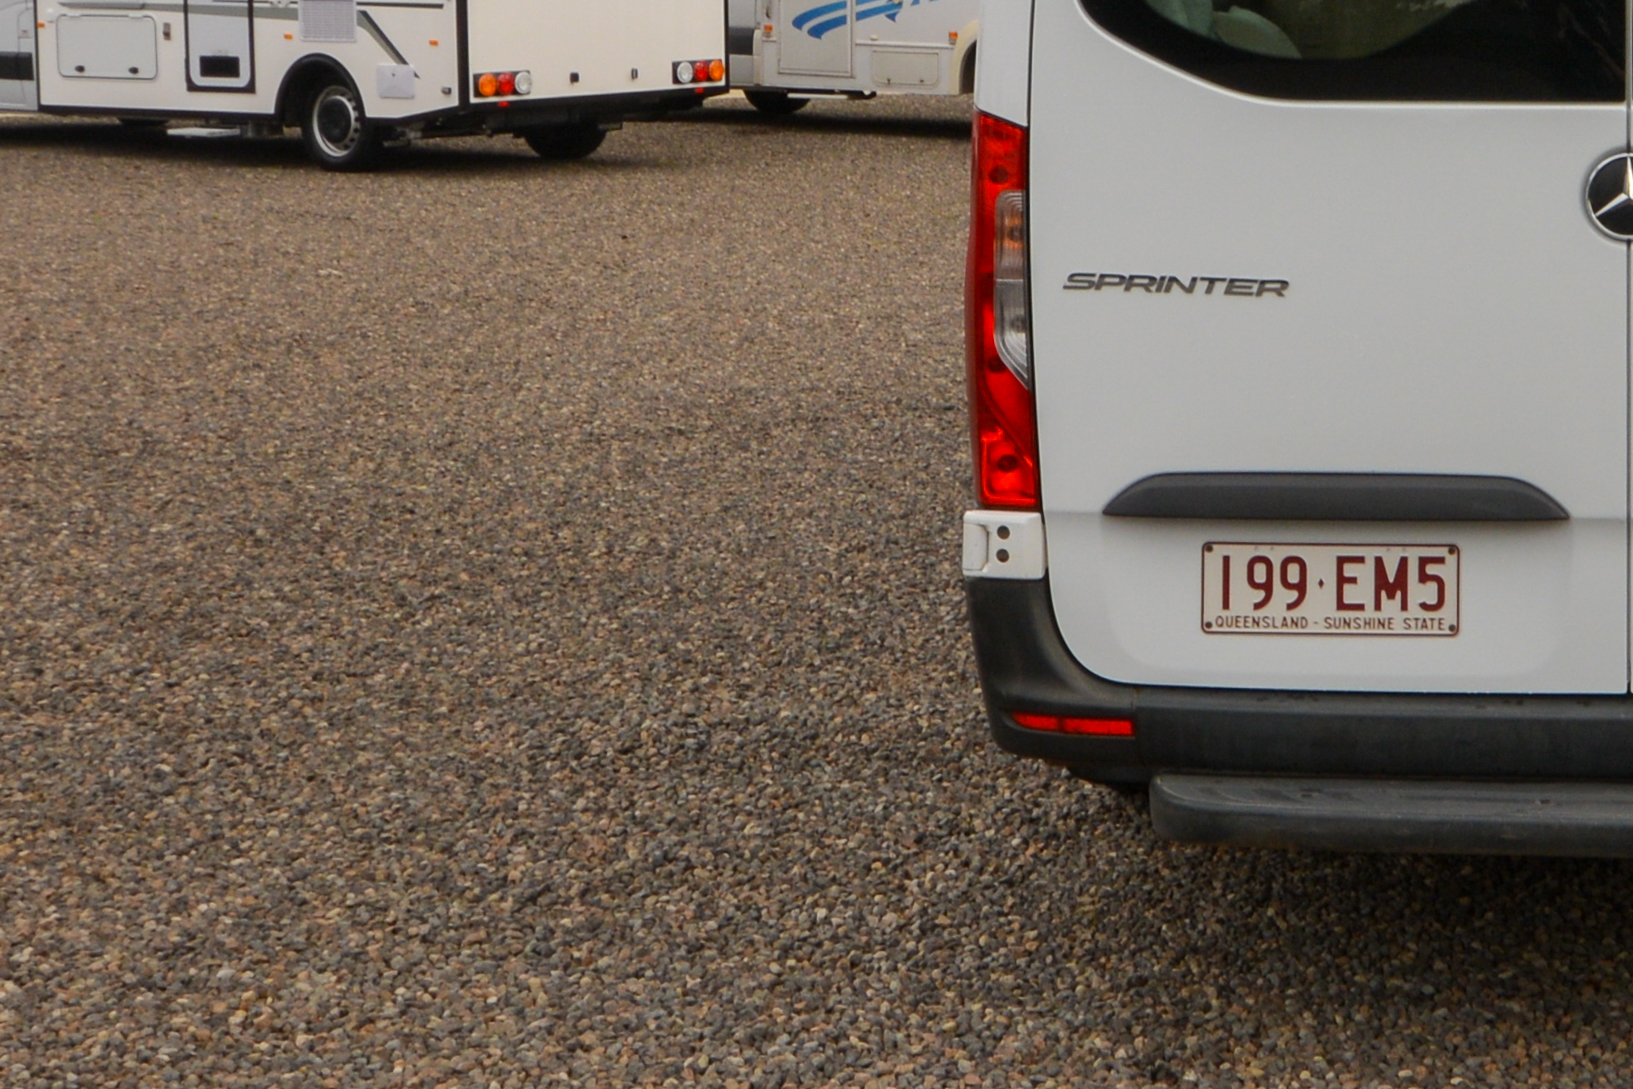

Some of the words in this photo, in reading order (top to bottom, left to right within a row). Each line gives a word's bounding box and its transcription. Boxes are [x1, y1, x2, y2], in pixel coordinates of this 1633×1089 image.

[1062, 272, 1290, 298] SPRINTER
[1214, 615, 1309, 630] QUEENSLAND
[1323, 616, 1395, 631] SUNSHINE
[1402, 617, 1446, 631] STATE
